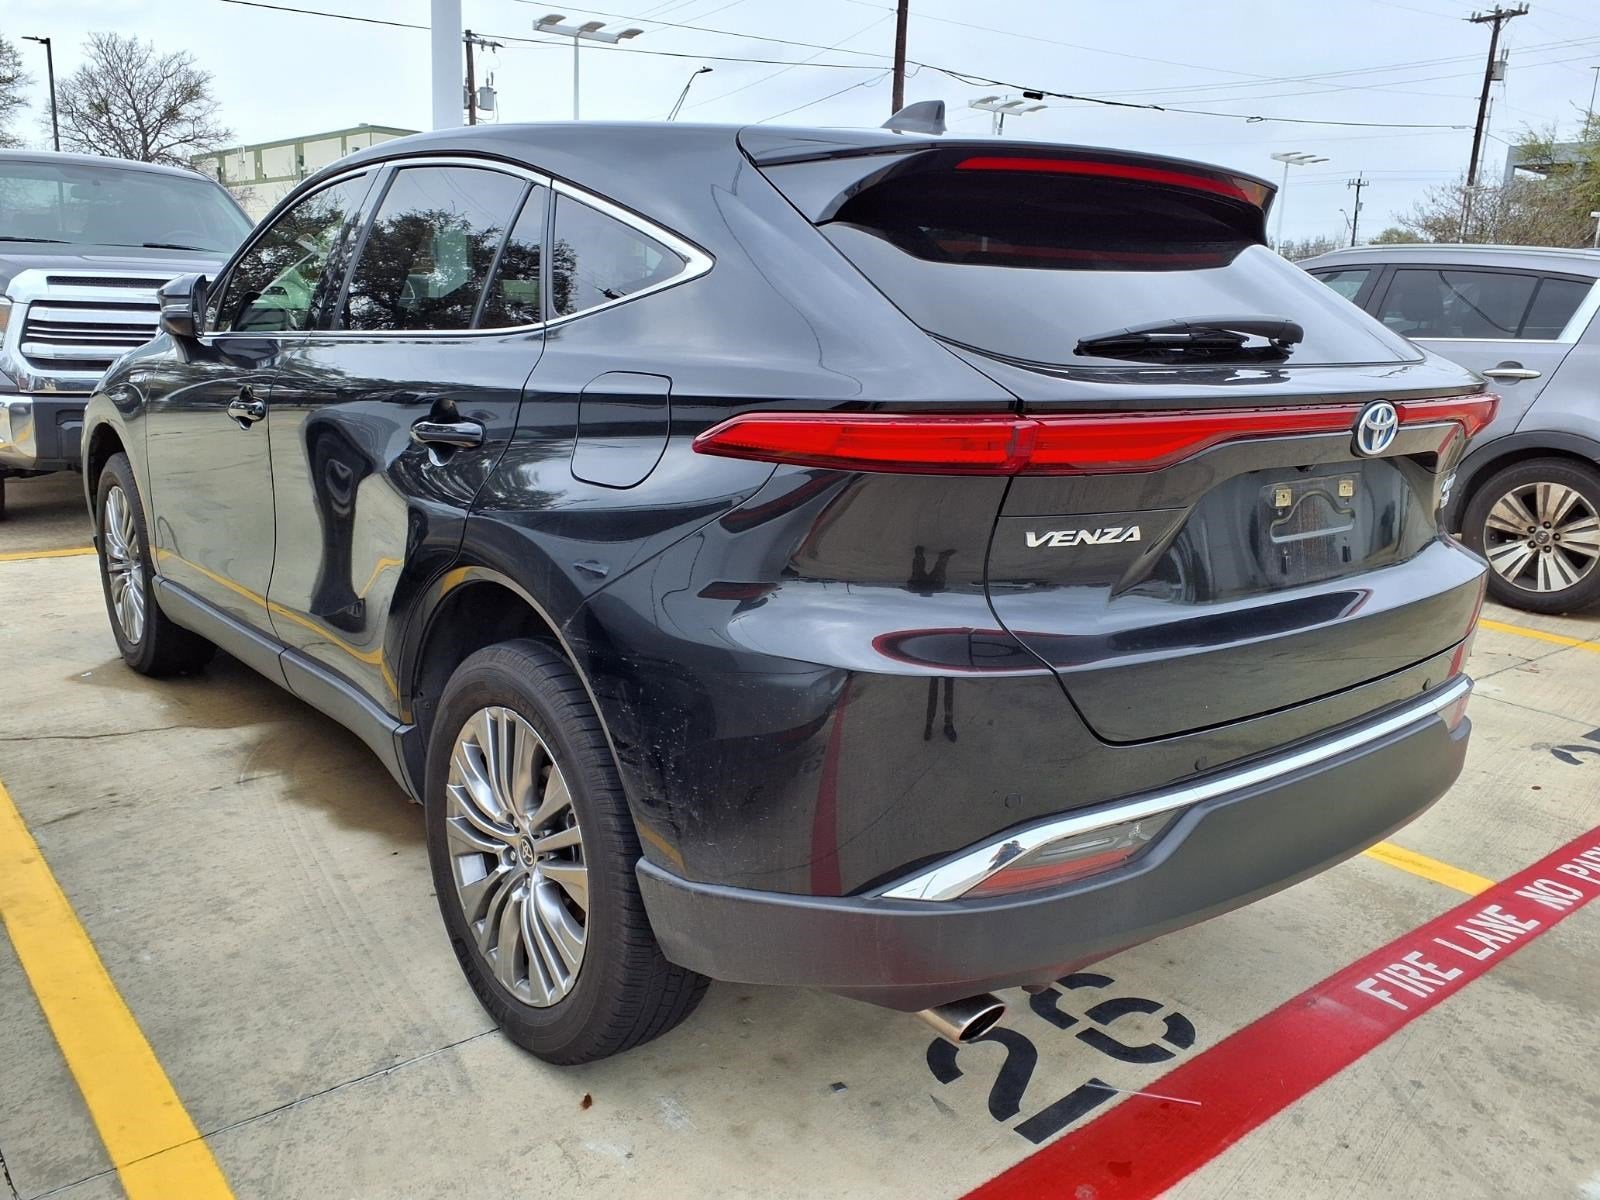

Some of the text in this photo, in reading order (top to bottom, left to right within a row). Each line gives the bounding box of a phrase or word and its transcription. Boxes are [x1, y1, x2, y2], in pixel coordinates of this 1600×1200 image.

[1025, 525, 1141, 548] VENZA
[1354, 950, 1465, 1011] FIRE
[1432, 904, 1541, 961] LANE
[1514, 878, 1584, 911] NO
[926, 972, 1197, 1145] 26
